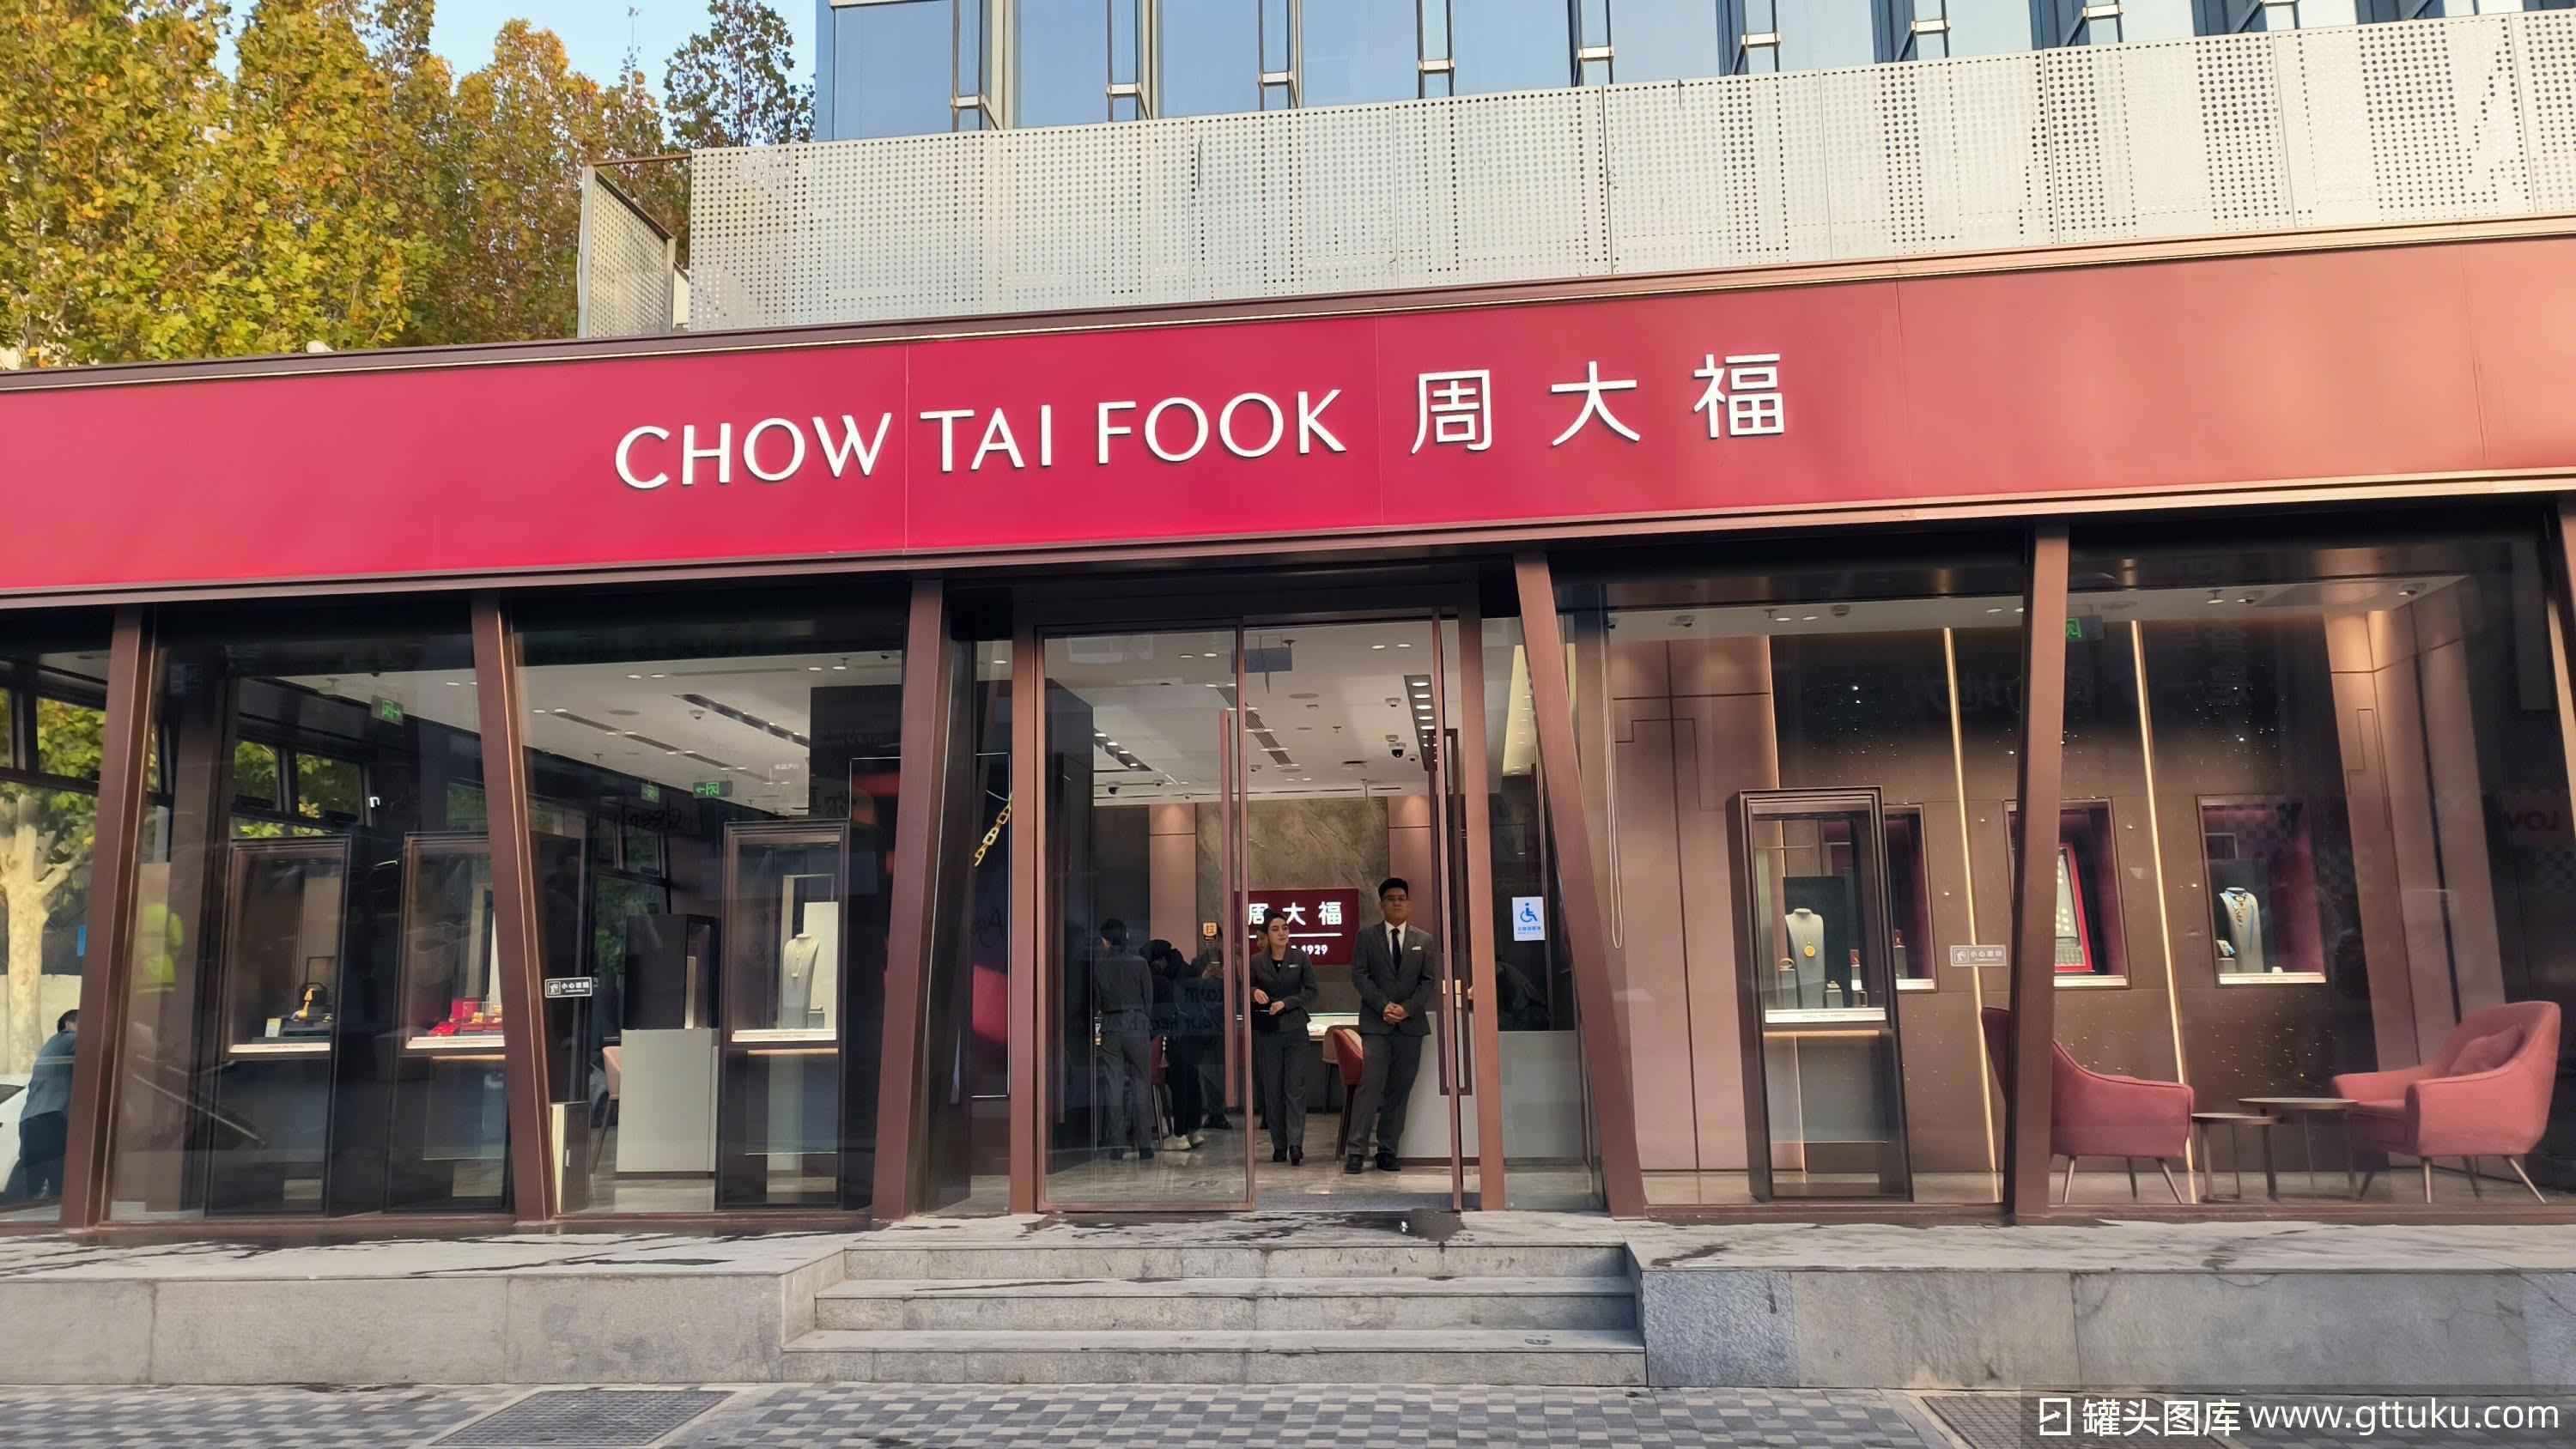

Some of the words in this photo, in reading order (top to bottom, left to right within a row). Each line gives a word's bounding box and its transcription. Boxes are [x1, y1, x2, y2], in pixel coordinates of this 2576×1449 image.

[617, 413, 891, 488] CHOW
[920, 405, 1051, 470] TAI
[1099, 390, 1345, 463] FOOK
[1413, 354, 1783, 453] 周大福
[1249, 900, 1342, 926] 周大福
